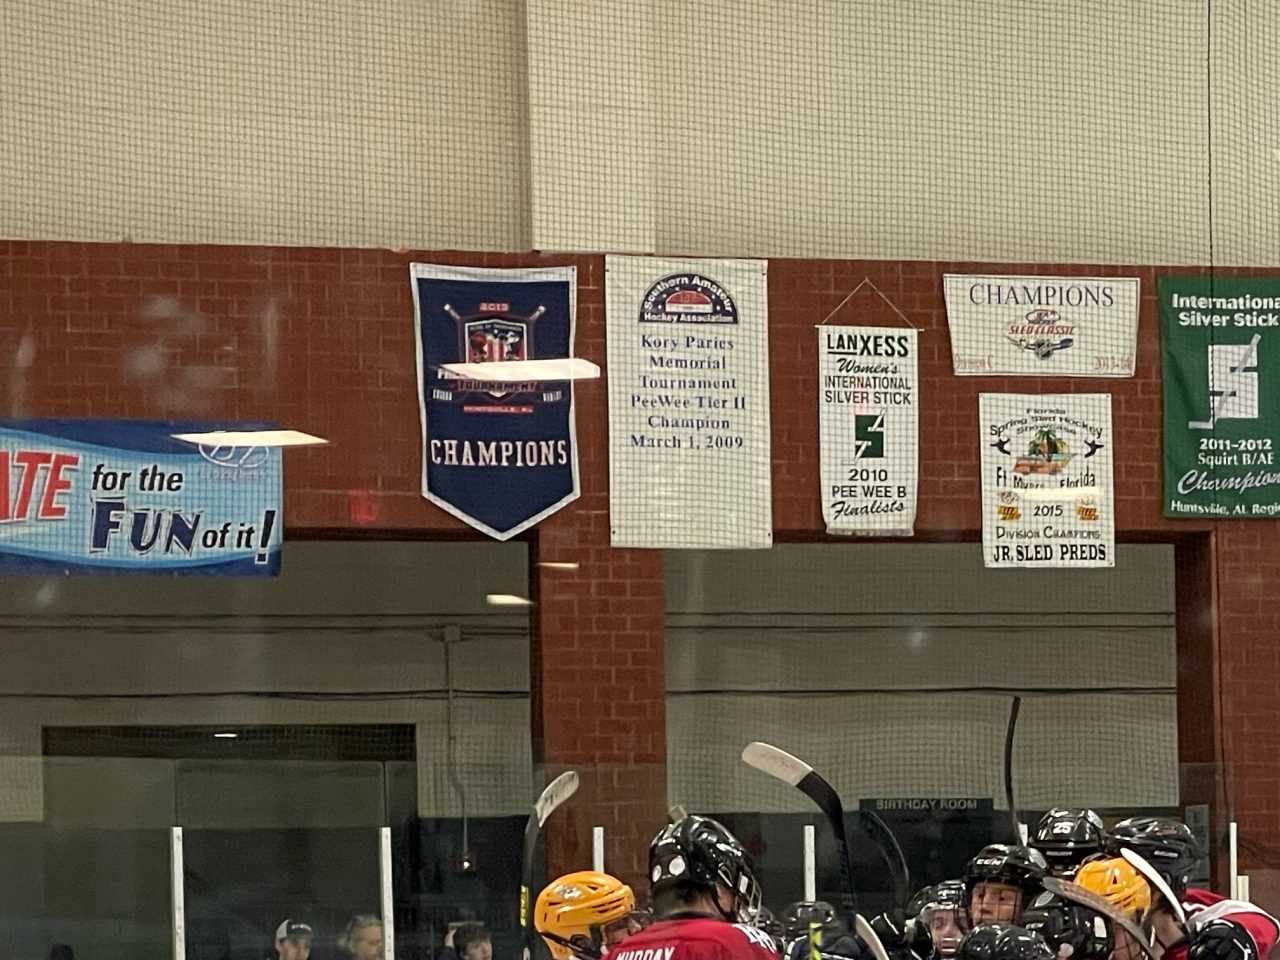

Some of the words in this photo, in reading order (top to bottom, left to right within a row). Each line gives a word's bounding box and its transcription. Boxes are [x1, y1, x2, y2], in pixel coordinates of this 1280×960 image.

[644, 276, 689, 309] Southern
[969, 284, 1114, 307] CHAMPIONS
[644, 313, 678, 323] Hockey
[1179, 312, 1230, 326] Silver
[1234, 312, 1280, 327] Stick
[641, 334, 678, 352] Kory
[827, 334, 909, 357] LANXESS
[650, 356, 726, 370] Memorial
[836, 358, 898, 375] Women's
[639, 375, 736, 390] Tournament
[824, 375, 911, 391] INTERNATIONAL
[631, 395, 690, 409] PeeWee
[695, 396, 728, 409] Tier
[824, 390, 869, 404] SILVER
[873, 391, 911, 405] STICK
[648, 416, 730, 431] Champion
[990, 419, 1028, 437] Spring
[631, 435, 681, 449] March
[705, 435, 743, 449] 2009
[1199, 438, 1272, 450] 2011-2012
[431, 439, 567, 466] CHAMPIONS
[1198, 452, 1238, 469] Squirt
[91, 464, 131, 491] for
[139, 465, 183, 492] the
[848, 469, 888, 481] 2010
[832, 485, 857, 498] PEE
[862, 486, 893, 498] WEE
[897, 486, 907, 498] B
[831, 500, 904, 520] Finalists
[1033, 505, 1064, 517] 2015
[90, 497, 201, 555] FUN
[202, 523, 226, 549] of
[994, 545, 1013, 562] JR.
[1017, 545, 1053, 562] SLED
[1060, 544, 1106, 561] PREDS
[876, 800, 936, 810] BIRTHDAY
[940, 800, 977, 810] ROOM
